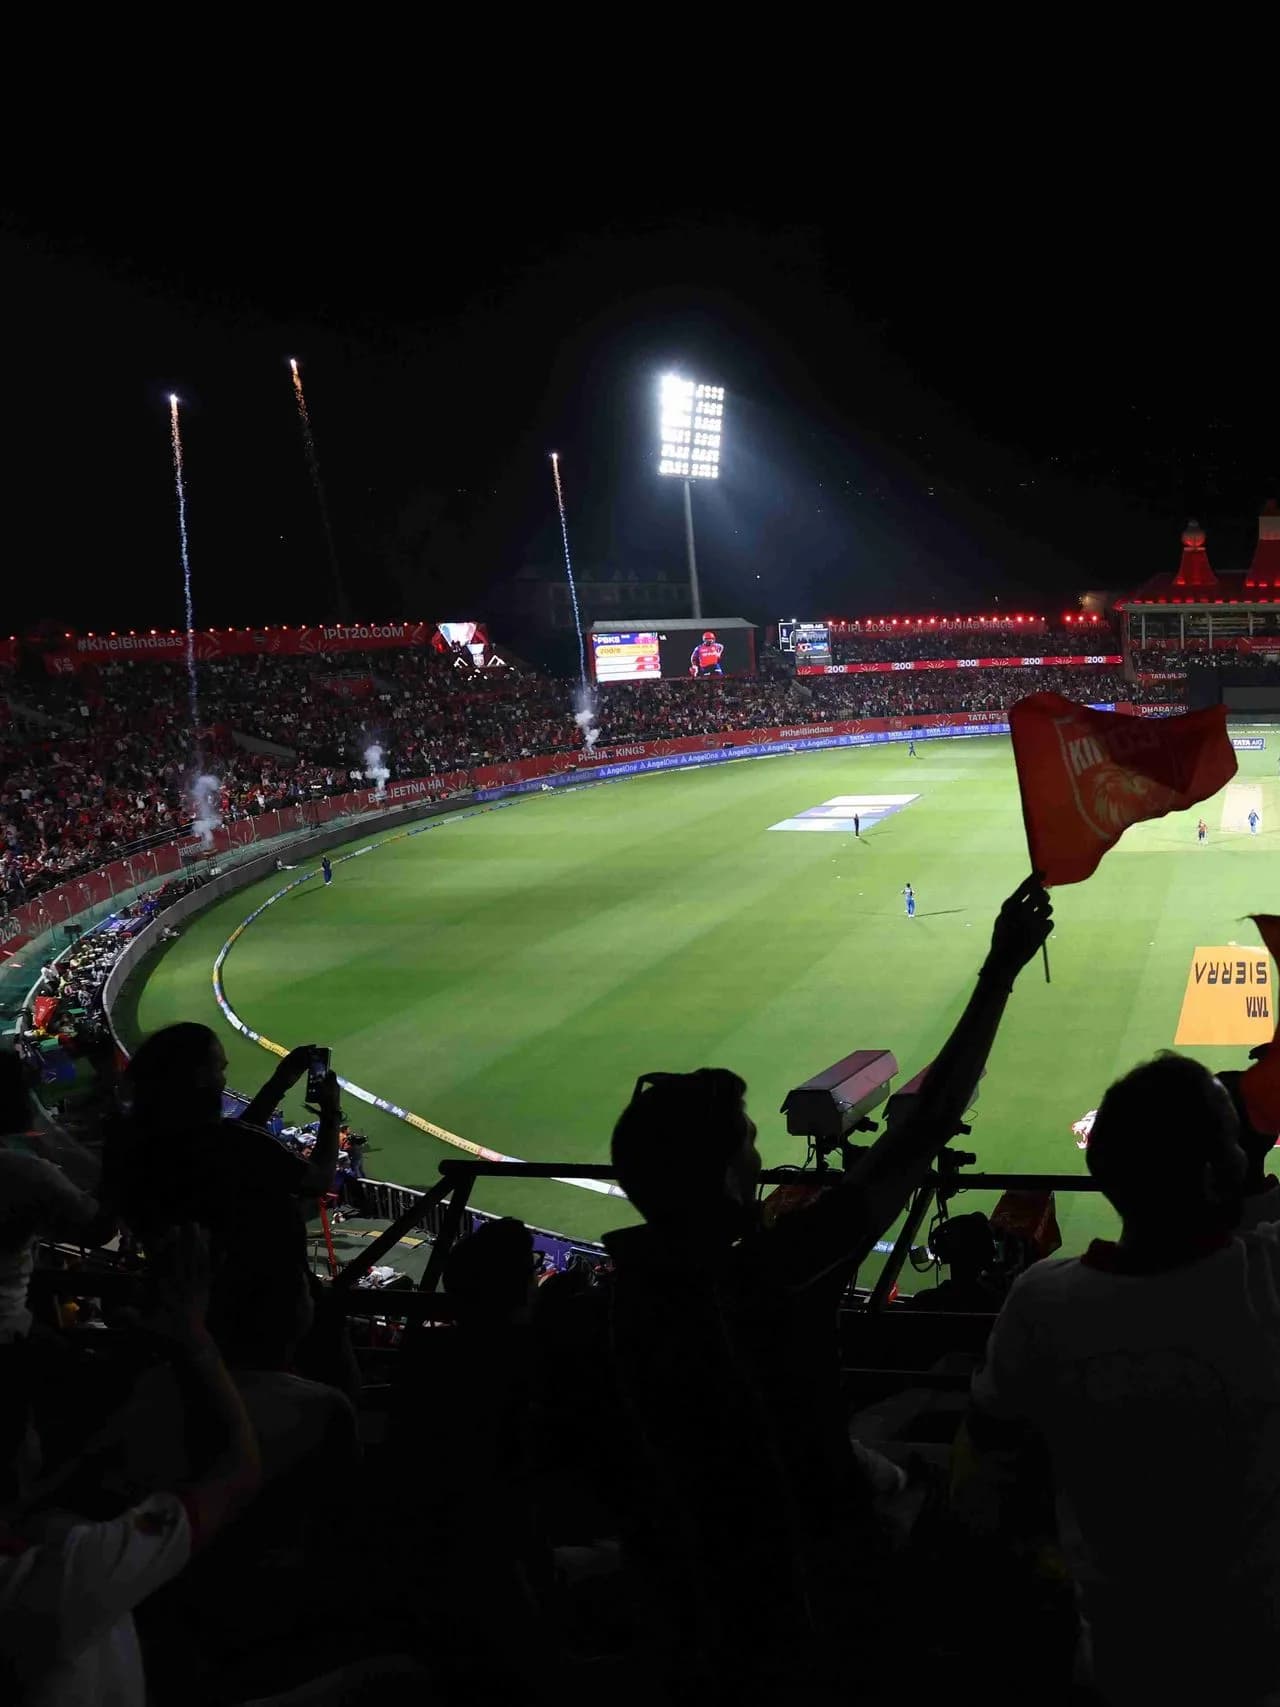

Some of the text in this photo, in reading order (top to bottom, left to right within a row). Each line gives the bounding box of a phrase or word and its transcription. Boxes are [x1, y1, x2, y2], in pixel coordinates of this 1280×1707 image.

[323, 626, 404, 640] IPLT20.COM
[848, 624, 865, 632] IPL
[865, 623, 892, 632] 2026
[77, 635, 184, 652] #KhelBindaas
[895, 662, 911, 670] 200
[960, 659, 977, 667] 200
[1088, 656, 1104, 664] 200
[828, 665, 844, 673] 200
[616, 746, 645, 757] KINGS
[688, 751, 719, 764] AngelOne
[728, 747, 758, 757] AngelOne
[647, 757, 678, 769] AngelOne
[607, 764, 637, 776] AngelOne
[389, 783, 426, 799] JEETNA
[428, 778, 445, 790] HAI
[1195, 961, 1267, 984] SIERRA
[1246, 996, 1269, 1018] TATA
